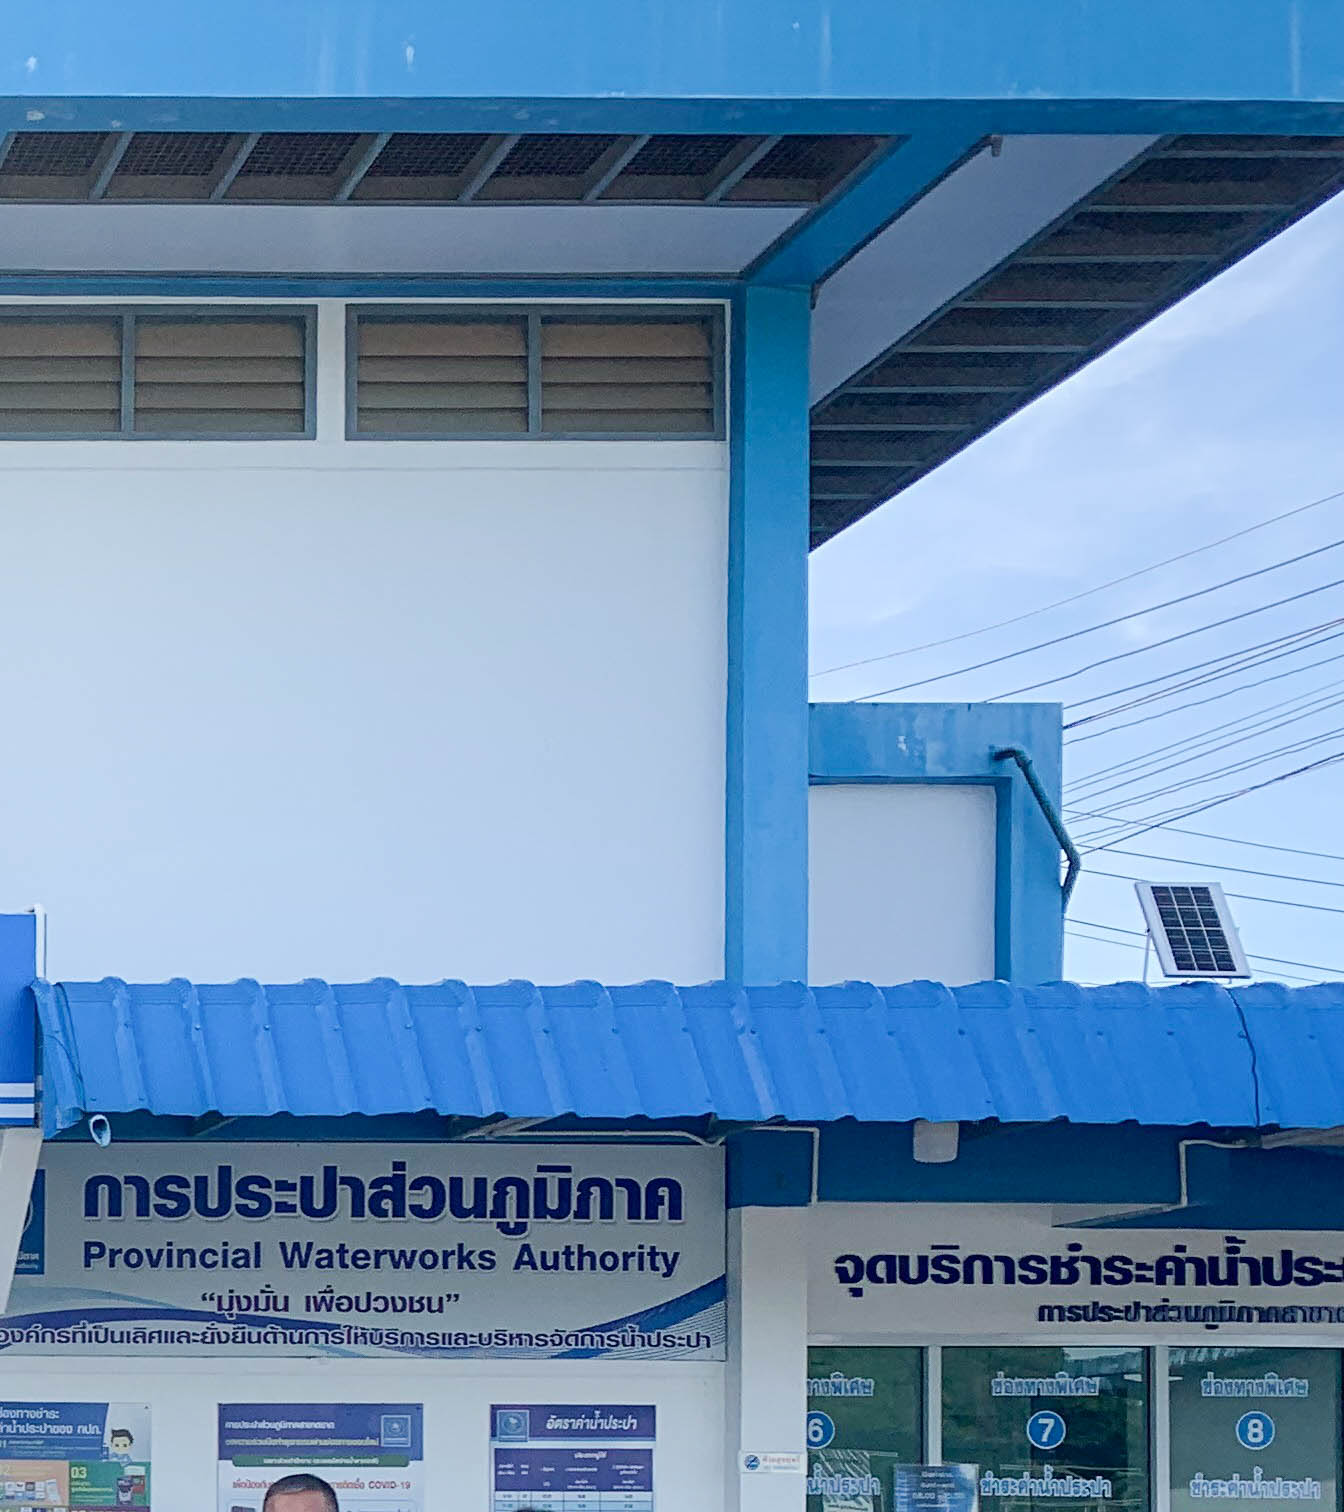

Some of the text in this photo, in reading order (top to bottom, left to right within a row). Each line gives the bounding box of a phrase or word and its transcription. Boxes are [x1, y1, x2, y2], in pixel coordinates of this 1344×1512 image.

[83, 1161, 683, 1237] การประปาส่วนภูมิภาค
[84, 1240, 681, 1278] Provincial Waterworks Authority
[991, 1371, 1100, 1397] ช่องทางพิเศษ
[1200, 1372, 1309, 1397] ช่องทางพิเศษ
[546, 1410, 638, 1431] อัตราค่าน้ำประปา
[807, 1419, 824, 1443] 6
[1037, 1418, 1056, 1443] 7
[1247, 1418, 1265, 1443] 8
[70, 1467, 87, 1479] 03
[368, 1479, 411, 1489] COVID-19
[980, 1465, 1112, 1497] ชำระค่าน้ำประปา
[1190, 1466, 1321, 1499] ชำระค่าน้ำประปา
